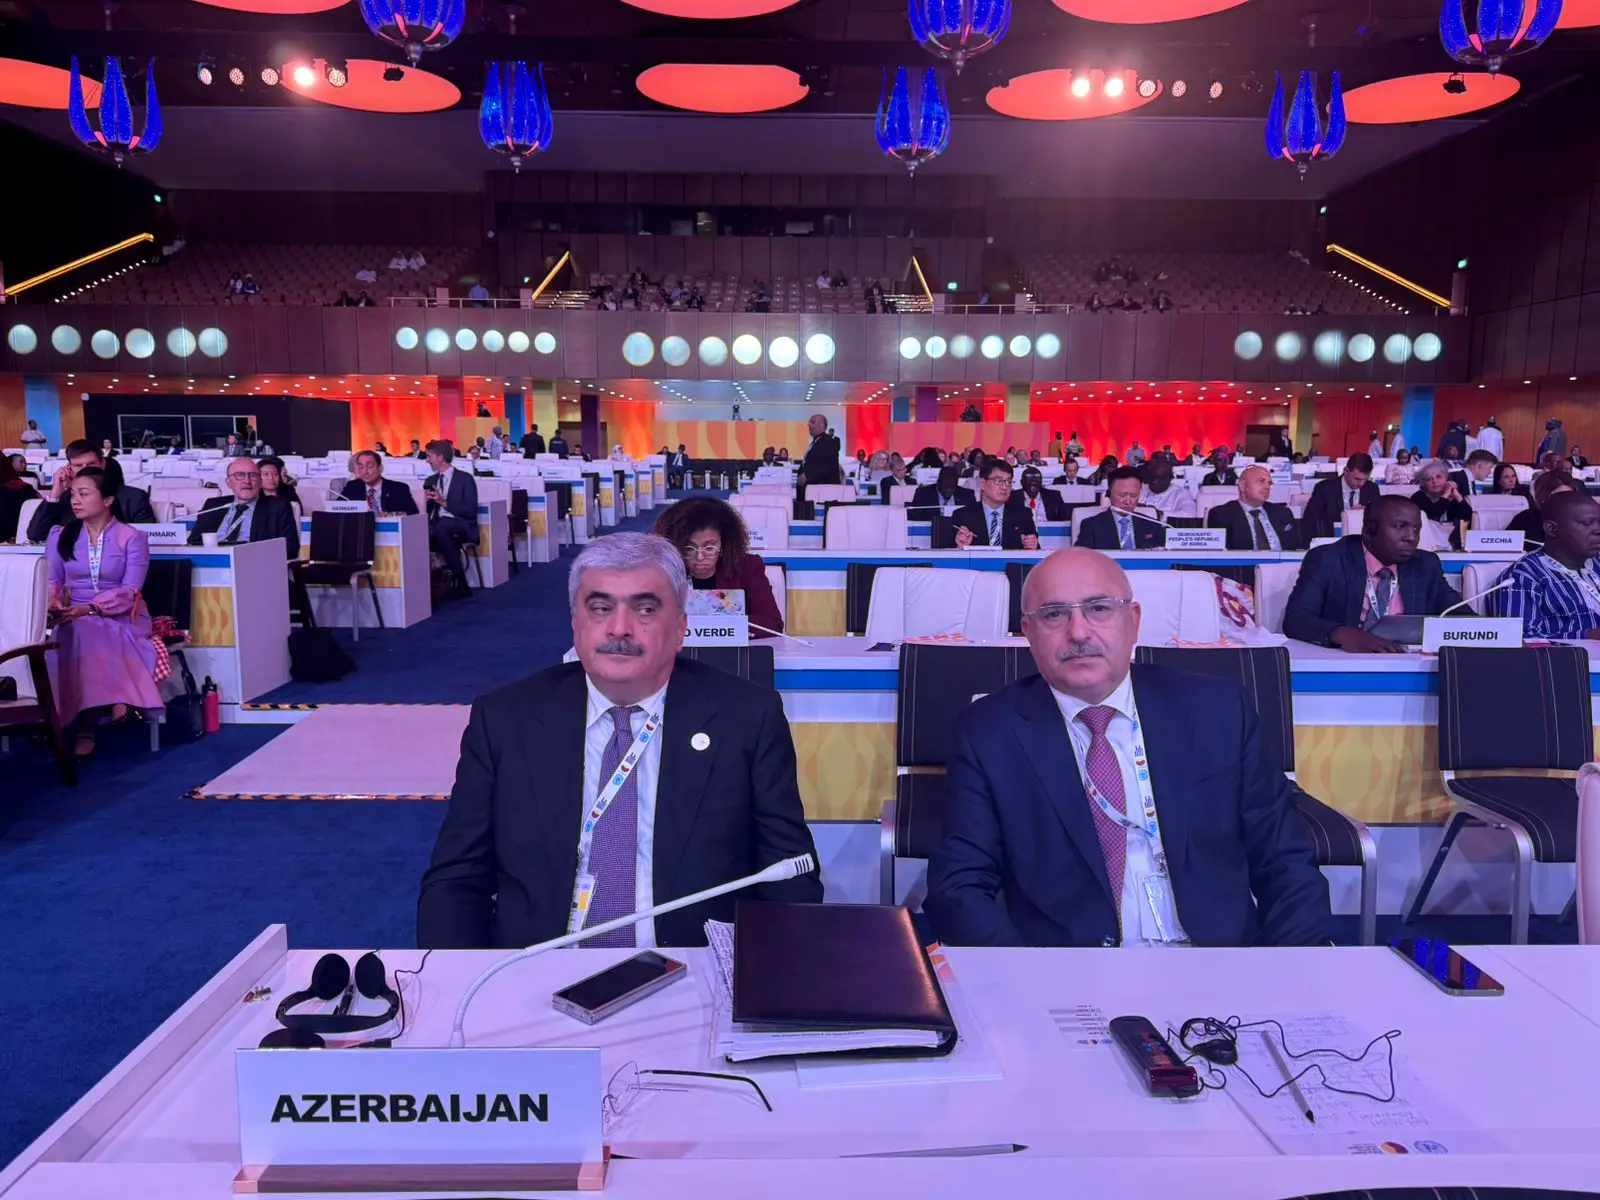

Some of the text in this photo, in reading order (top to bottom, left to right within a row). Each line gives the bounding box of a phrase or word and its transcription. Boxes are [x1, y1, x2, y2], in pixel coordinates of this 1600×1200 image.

[694, 628, 735, 637] VERDE
[1443, 631, 1498, 640] BURUNDI
[270, 1093, 549, 1123] AZERBAIJAN
